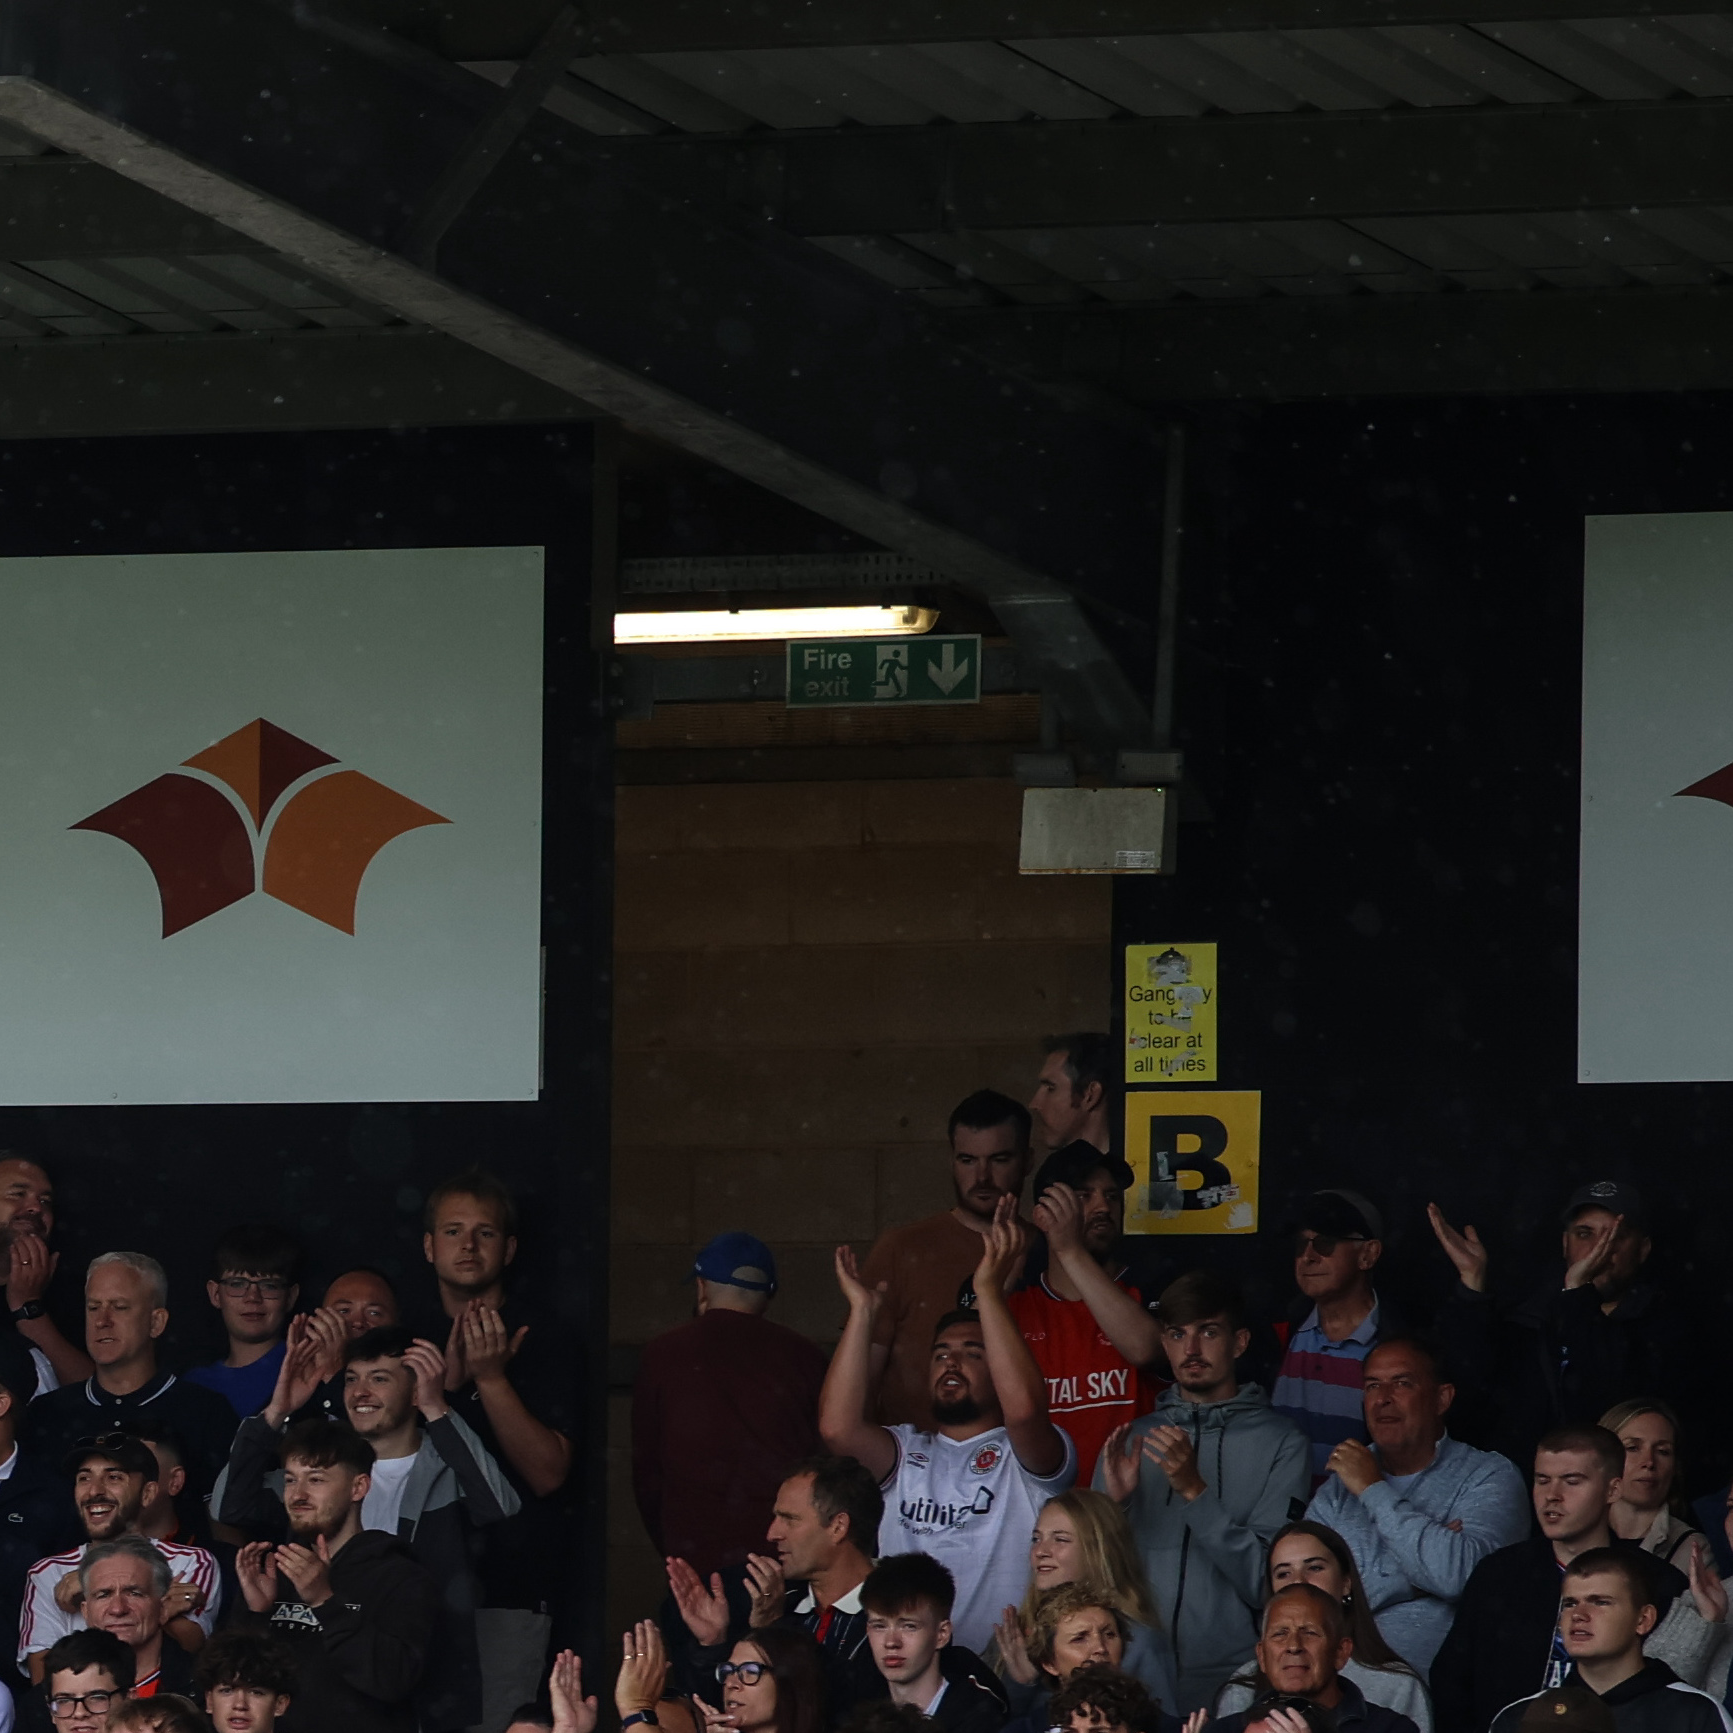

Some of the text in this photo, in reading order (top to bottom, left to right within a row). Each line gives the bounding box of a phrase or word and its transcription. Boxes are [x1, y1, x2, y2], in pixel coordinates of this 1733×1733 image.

[803, 648, 853, 671] Fire
[803, 675, 850, 697] exit
[1129, 985, 1213, 1005] Gangy
[1139, 1032, 1203, 1049] clear at
[1134, 1057, 1154, 1073] all
[1149, 1114, 1230, 1212] B
[1087, 1368, 1129, 1398] SKY
